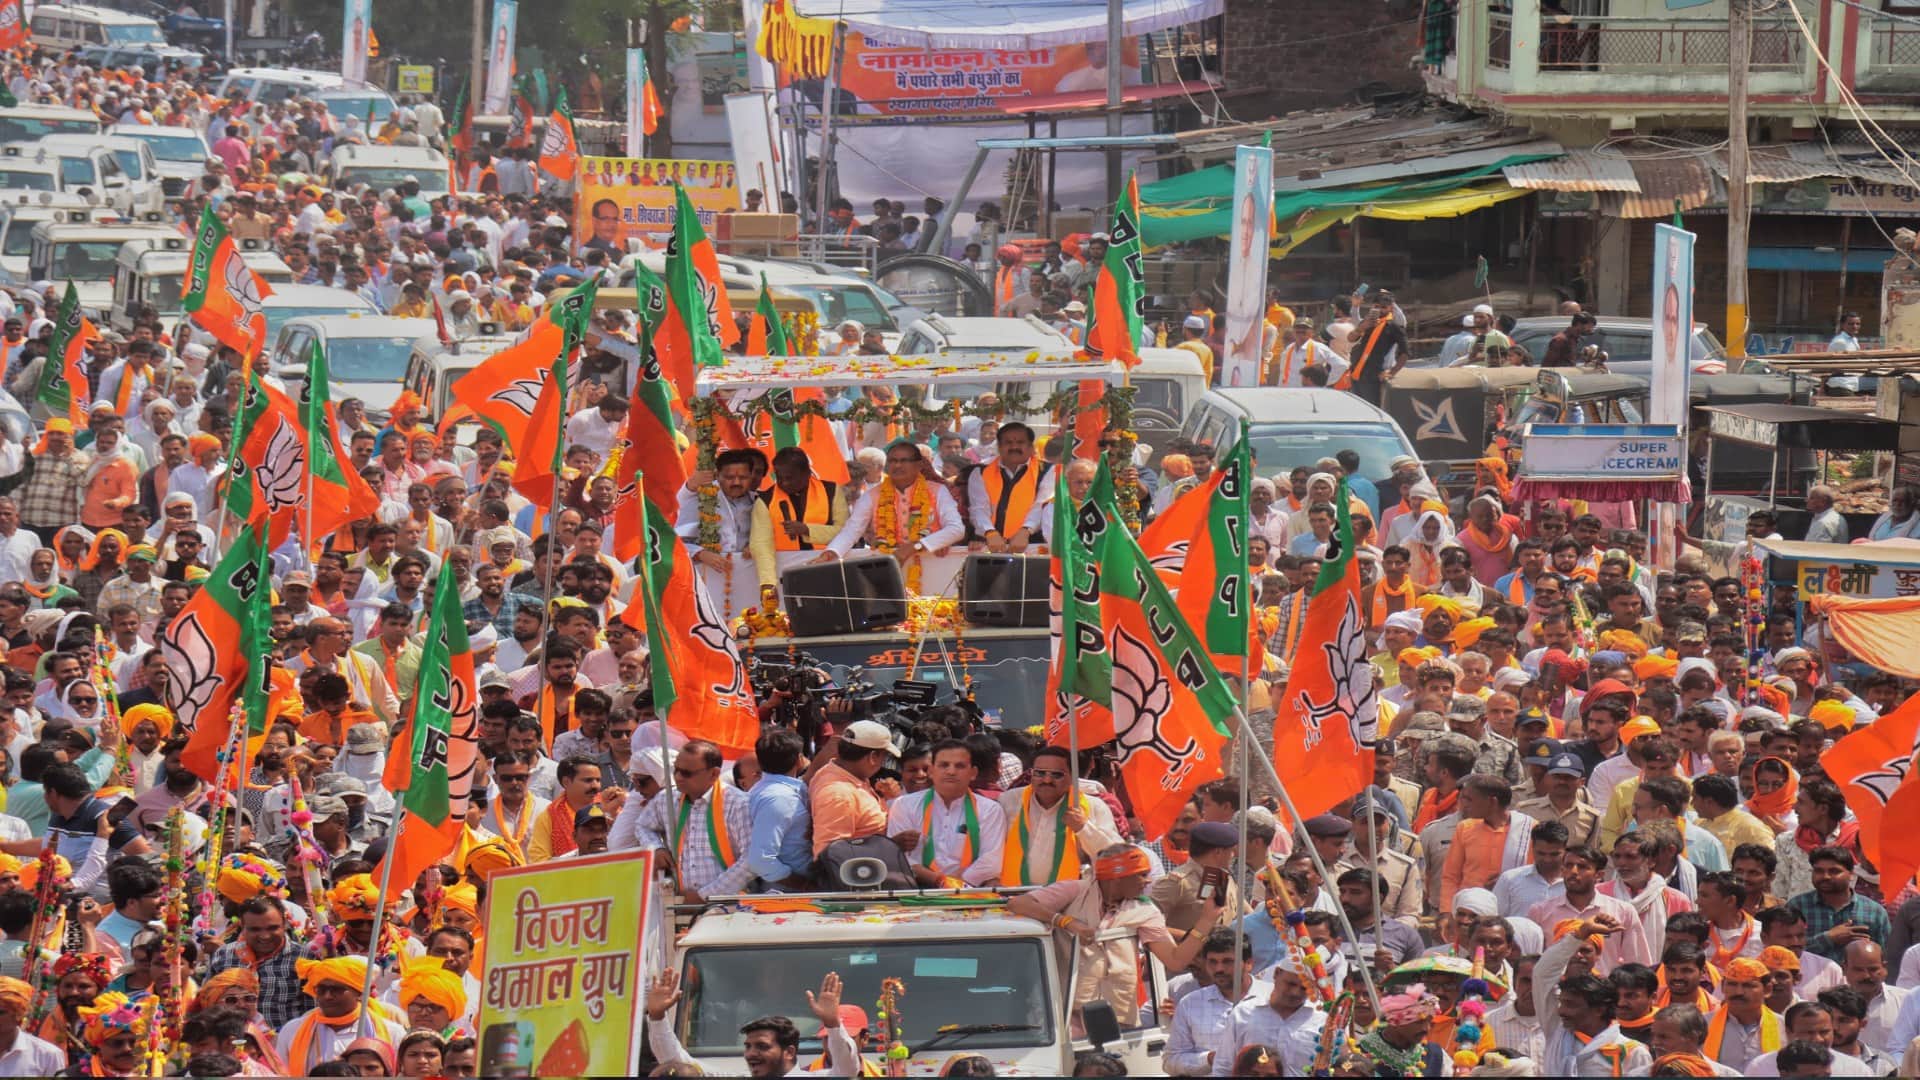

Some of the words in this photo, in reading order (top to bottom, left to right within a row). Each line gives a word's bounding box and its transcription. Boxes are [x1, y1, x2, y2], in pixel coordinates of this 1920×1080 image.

[897, 70, 907, 88] में
[941, 70, 964, 87] सभी
[1005, 71, 1020, 85] का
[1619, 442, 1668, 453] SUPER
[514, 888, 613, 953] विजय
[487, 956, 578, 1010] धमाल
[581, 952, 630, 1021] ग्रुप
